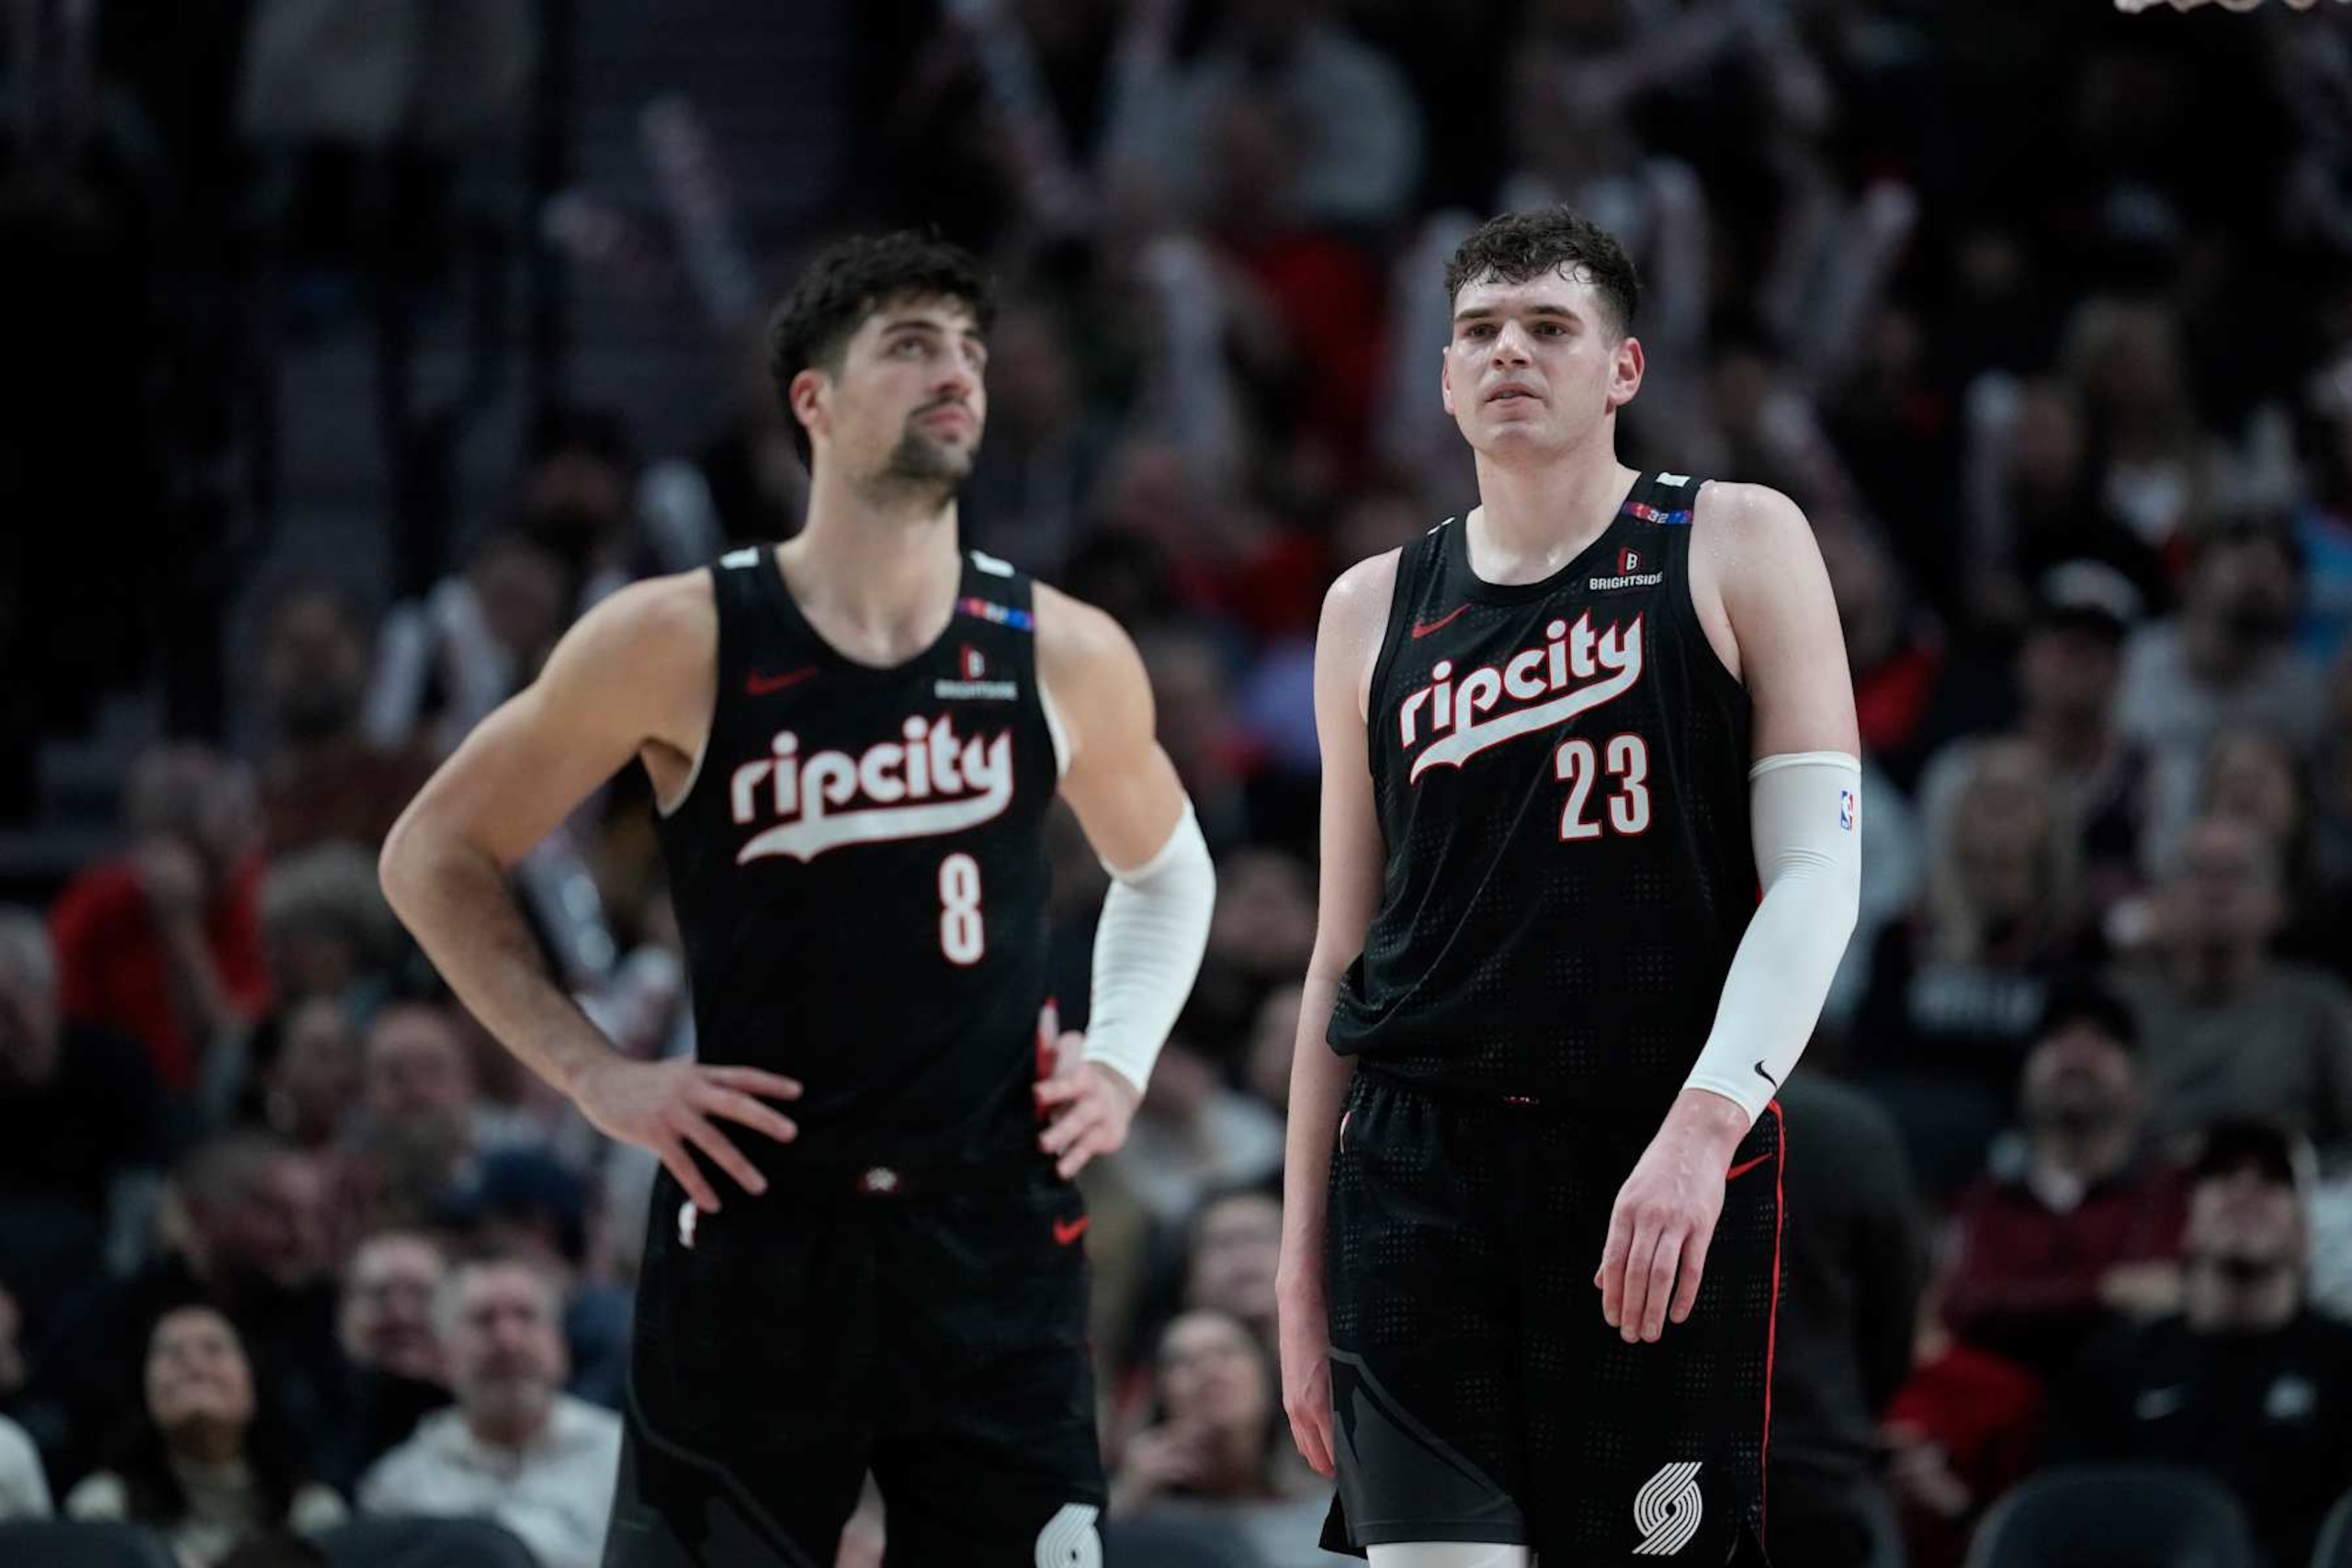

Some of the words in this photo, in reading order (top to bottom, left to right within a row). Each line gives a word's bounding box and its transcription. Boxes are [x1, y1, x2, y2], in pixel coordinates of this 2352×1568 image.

[1589, 570, 1663, 590] BRIGHTSIDE
[1399, 610, 1645, 785] ripcity
[730, 713, 1013, 865] ripcity
[1555, 733, 1651, 840] 23
[938, 852, 985, 964] 8
